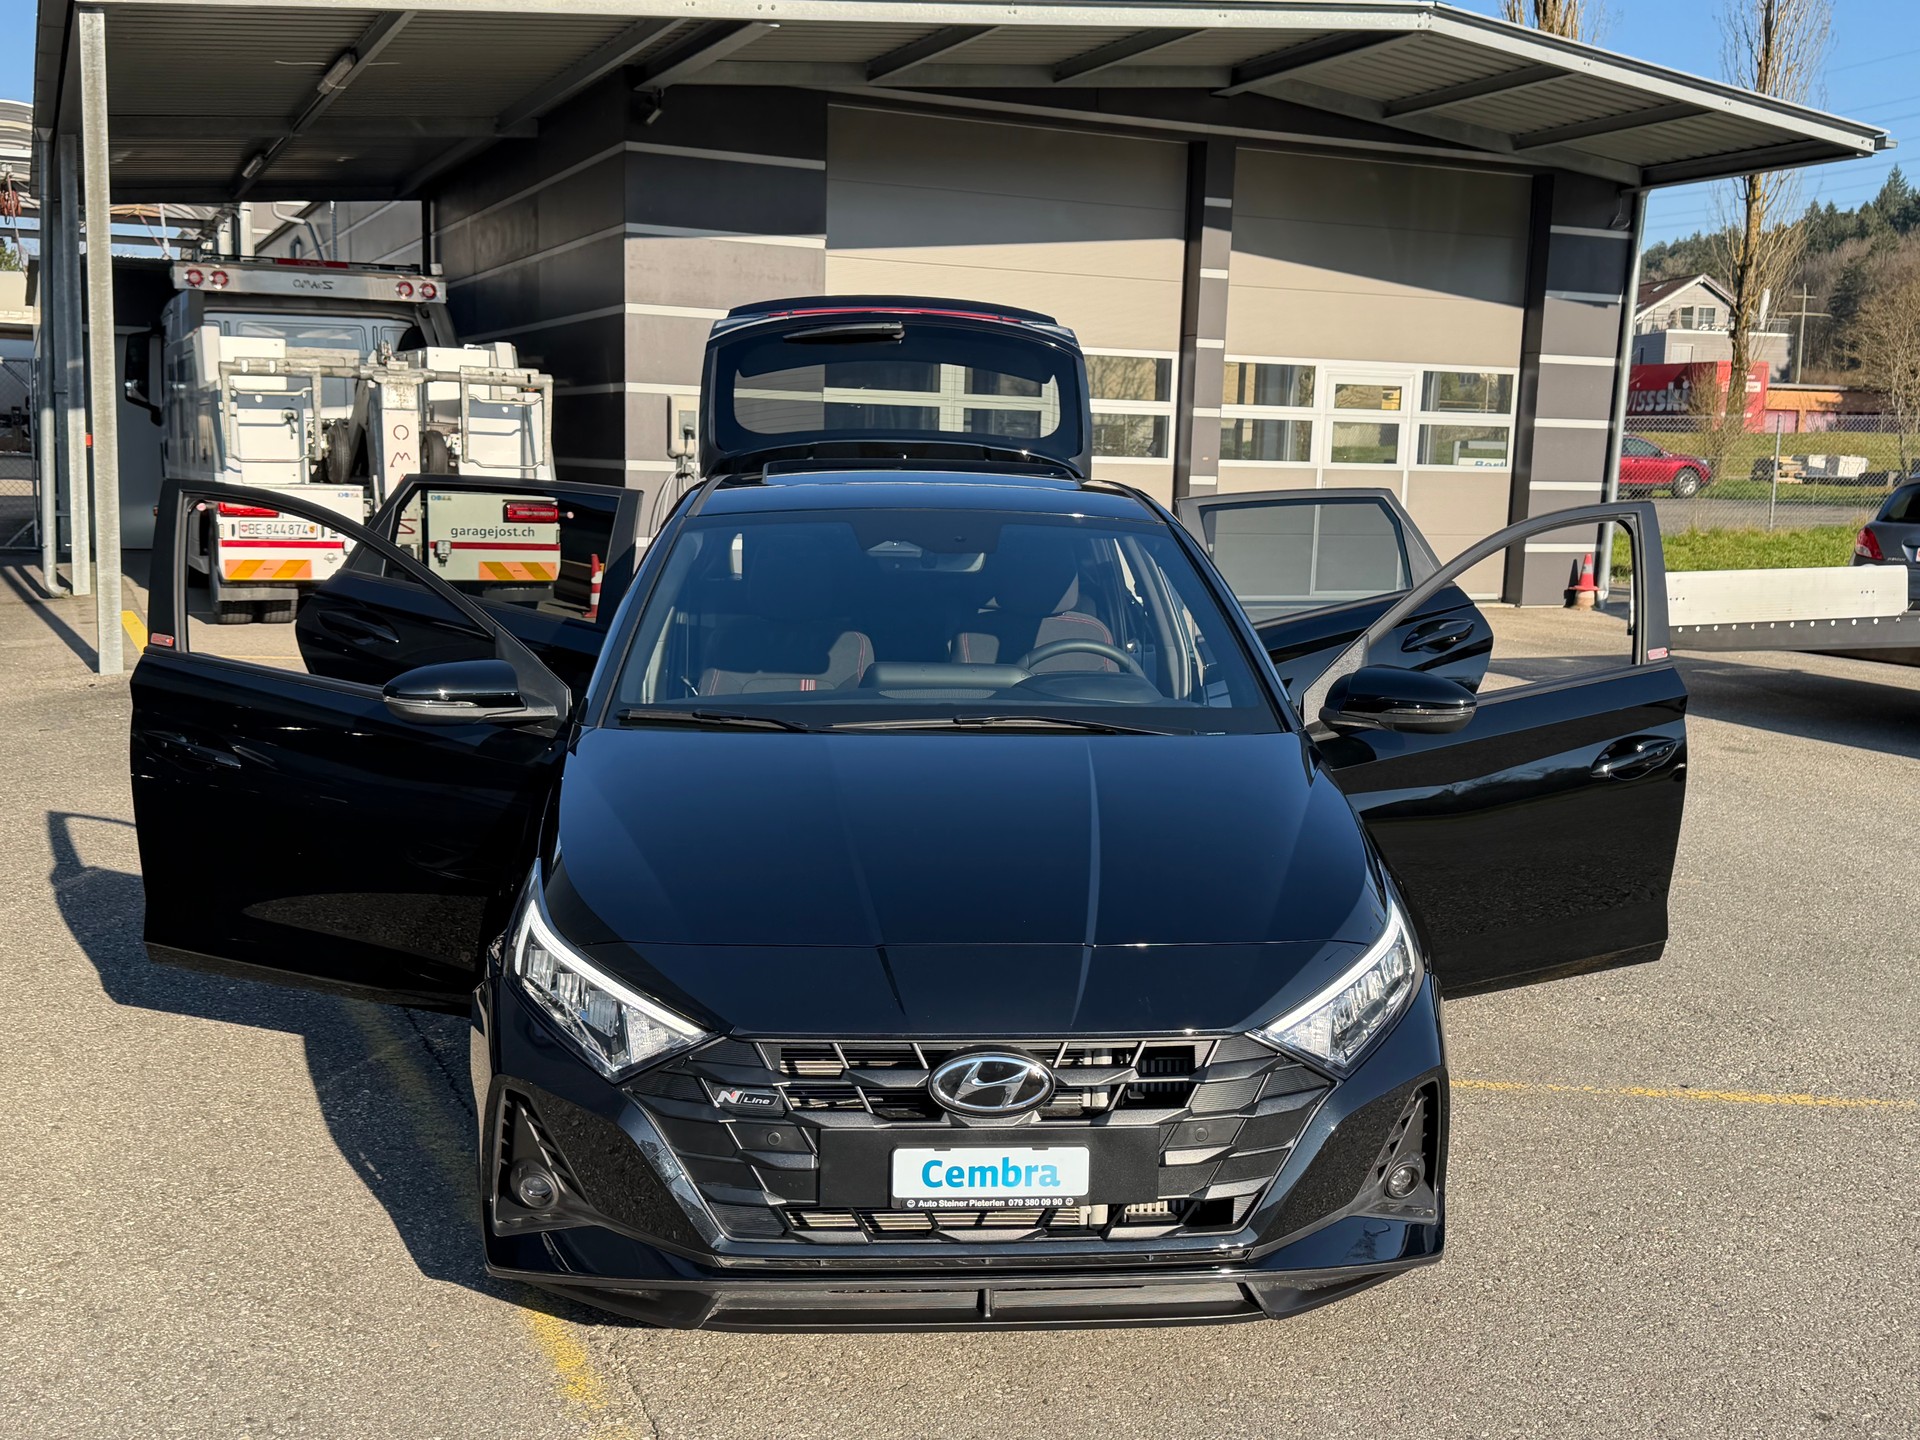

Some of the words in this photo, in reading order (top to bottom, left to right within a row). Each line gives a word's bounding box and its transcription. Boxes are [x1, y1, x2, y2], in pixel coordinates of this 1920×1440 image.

[450, 526, 535, 539] garagejost.ch
[743, 1097, 770, 1105] Line
[921, 1156, 1061, 1189] Cembra
[918, 1199, 938, 1208] Auto
[938, 1199, 968, 1208] Steiner
[1008, 1198, 1024, 1207] 079
[1024, 1198, 1040, 1207] 380
[1041, 1198, 1051, 1207] 09
[1052, 1198, 1063, 1206] 90
